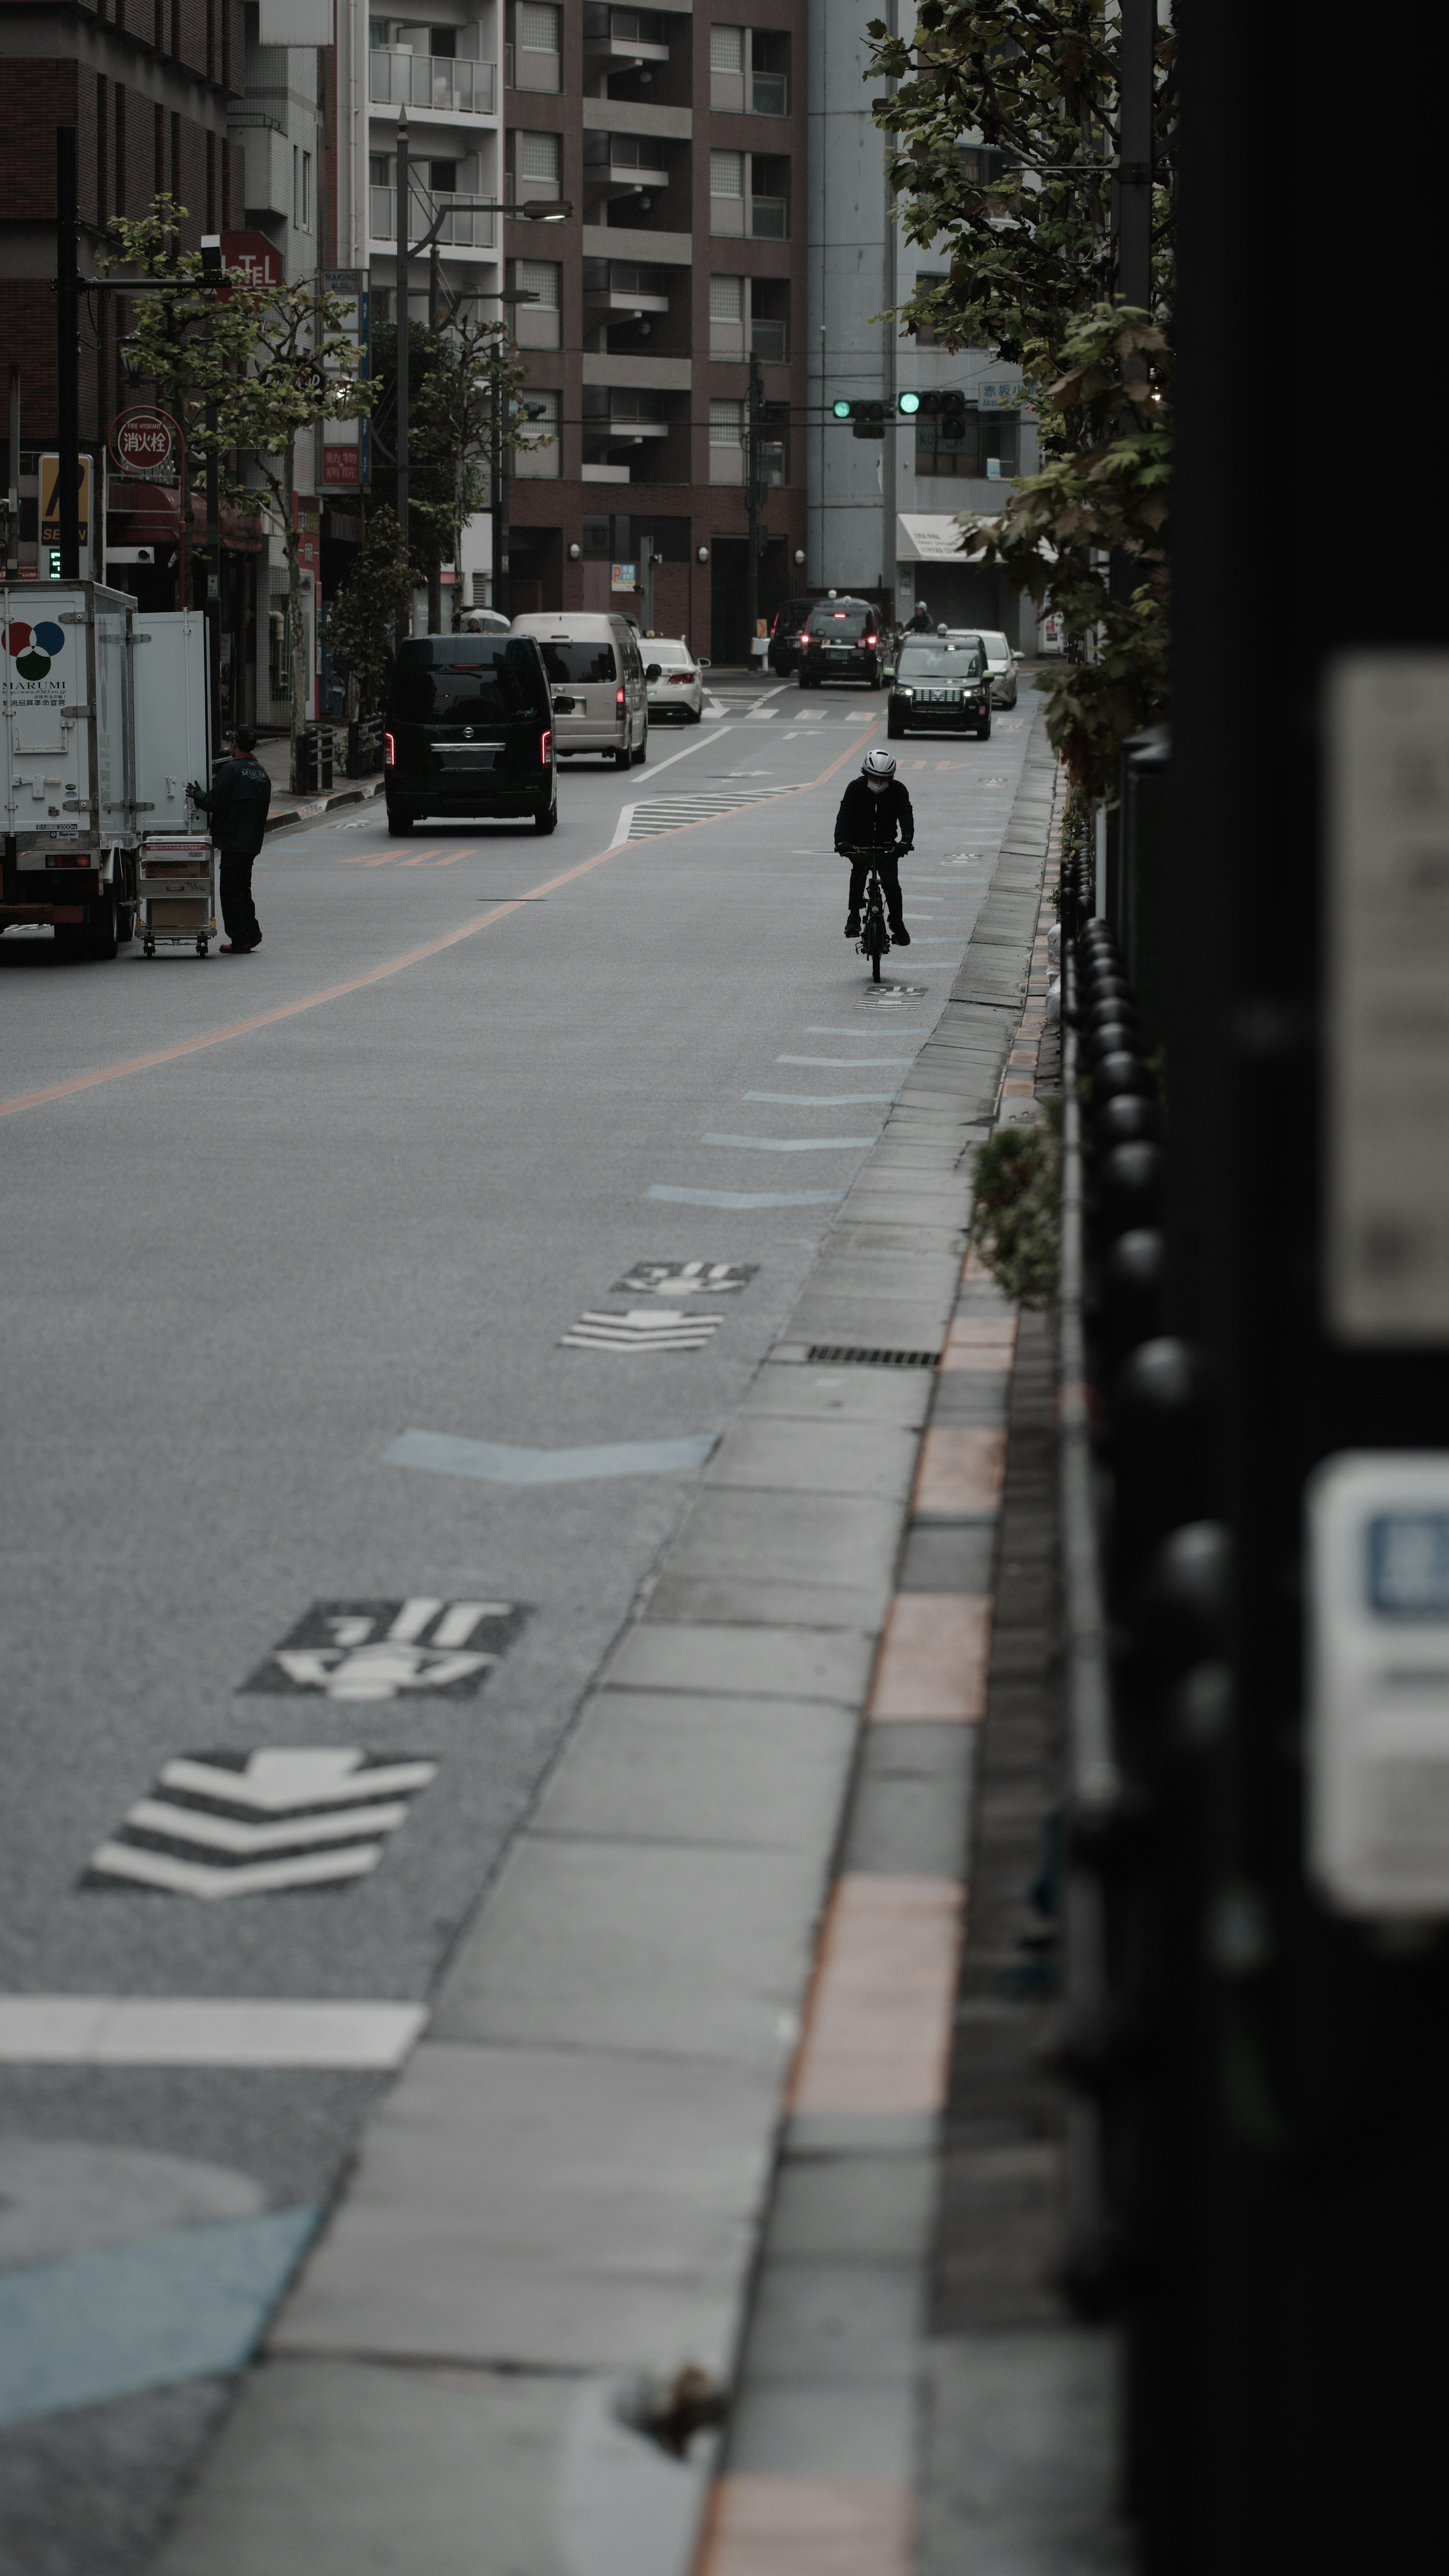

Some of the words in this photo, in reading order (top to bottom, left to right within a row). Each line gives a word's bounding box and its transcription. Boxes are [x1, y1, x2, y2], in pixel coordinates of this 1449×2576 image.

[124, 432, 166, 452] 消火栓
[43, 529, 86, 540] SEN
[2, 681, 66, 690] MARUMI
